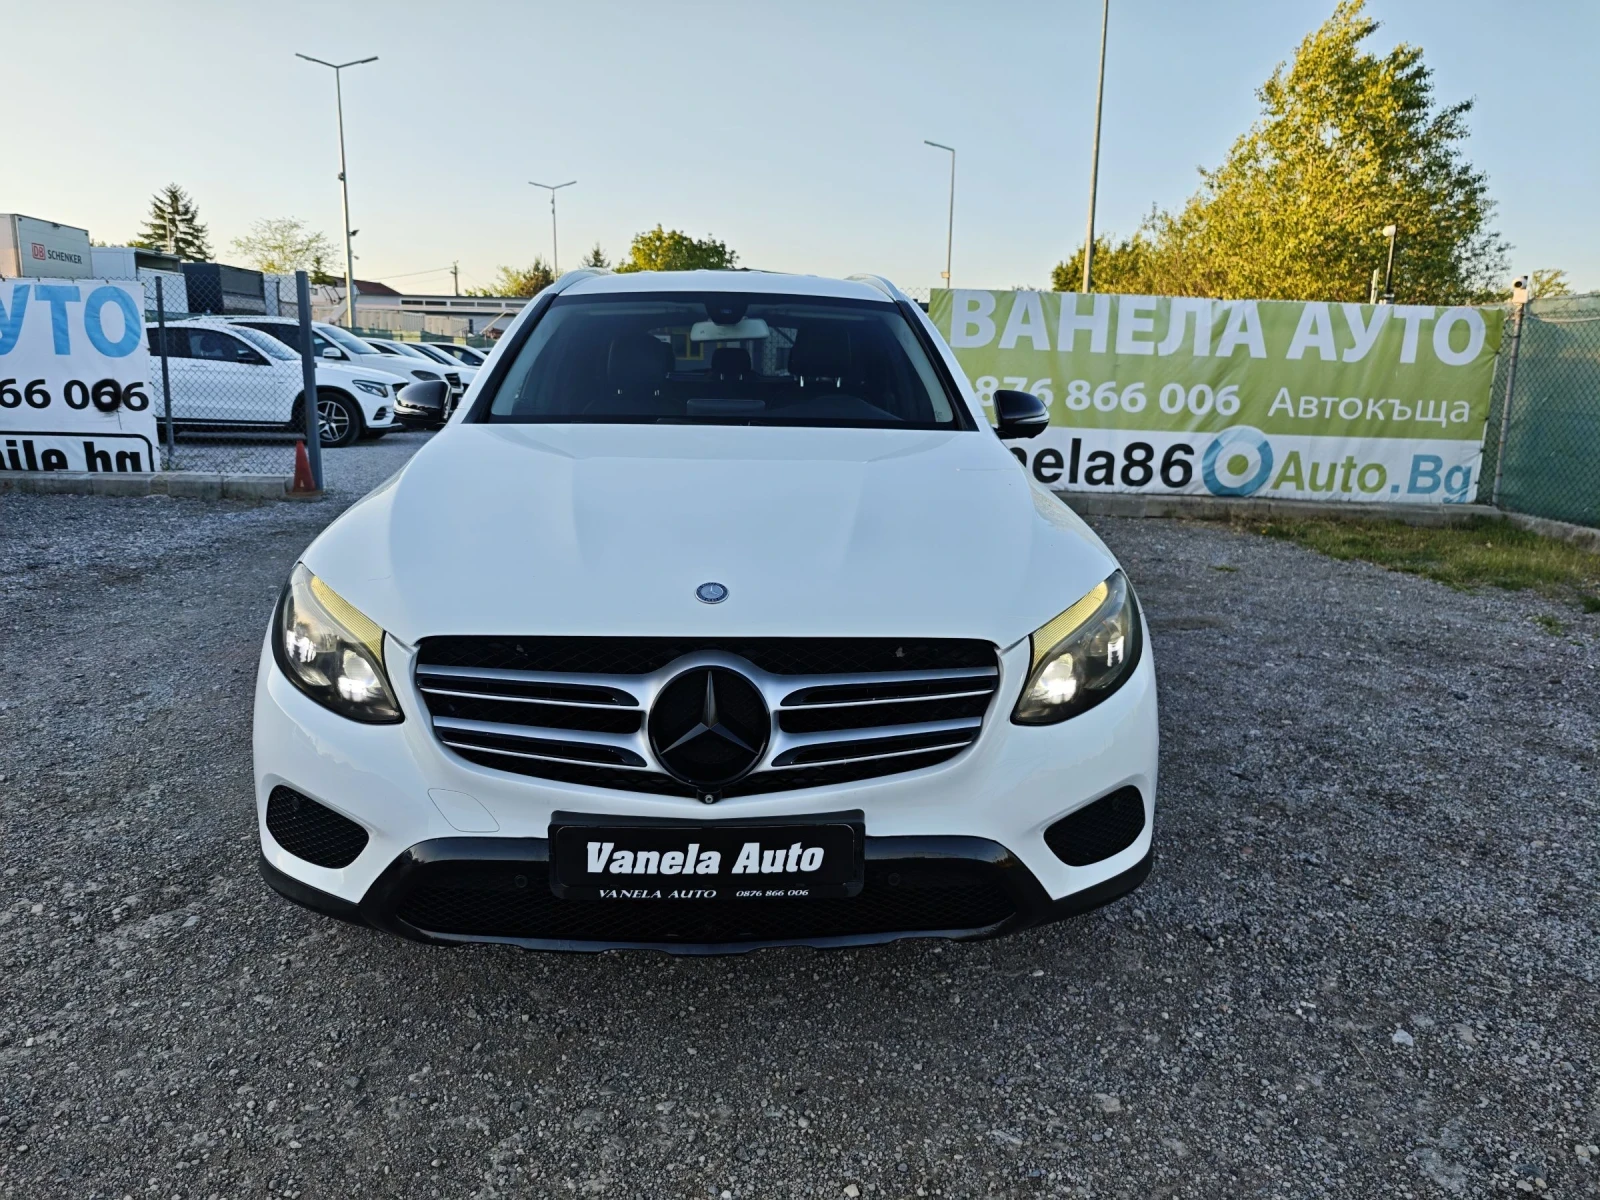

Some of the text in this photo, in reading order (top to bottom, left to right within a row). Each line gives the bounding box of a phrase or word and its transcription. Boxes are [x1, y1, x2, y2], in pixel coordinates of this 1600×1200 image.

[47, 249, 83, 264] SCHENKER
[950, 289, 1487, 367] ВАНЕЛА АУТО
[970, 375, 1241, 417] 876 866 006
[1267, 387, 1470, 428] Автокъща
[1272, 450, 1472, 503] Auto.Bg
[586, 841, 825, 875] Vanela Auto
[599, 889, 662, 899] VANELA
[668, 889, 717, 899] AUTO
[765, 889, 785, 897] 866
[787, 889, 809, 897] 006
